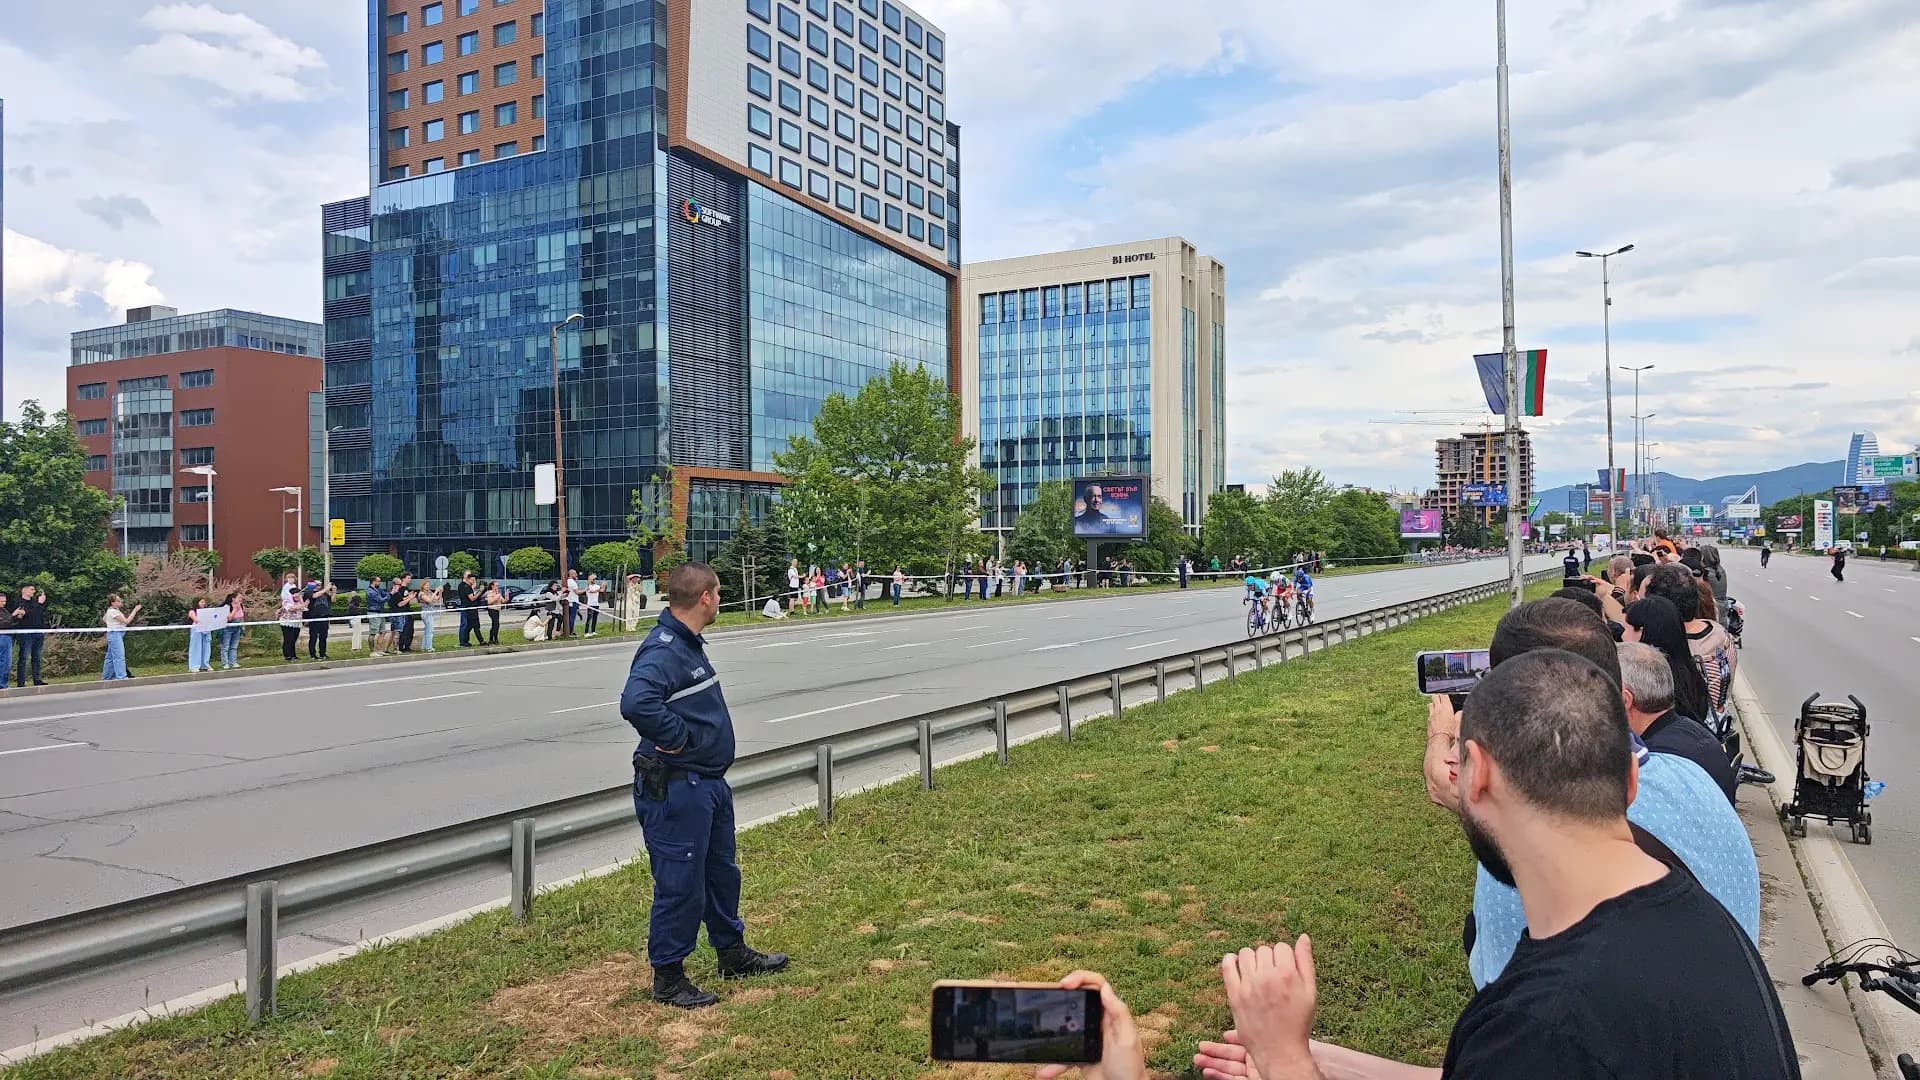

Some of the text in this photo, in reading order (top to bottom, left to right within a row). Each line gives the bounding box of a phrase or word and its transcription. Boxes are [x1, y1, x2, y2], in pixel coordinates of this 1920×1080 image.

[701, 215, 721, 227] GROUP
[1112, 252, 1155, 264] BI HOTEL
